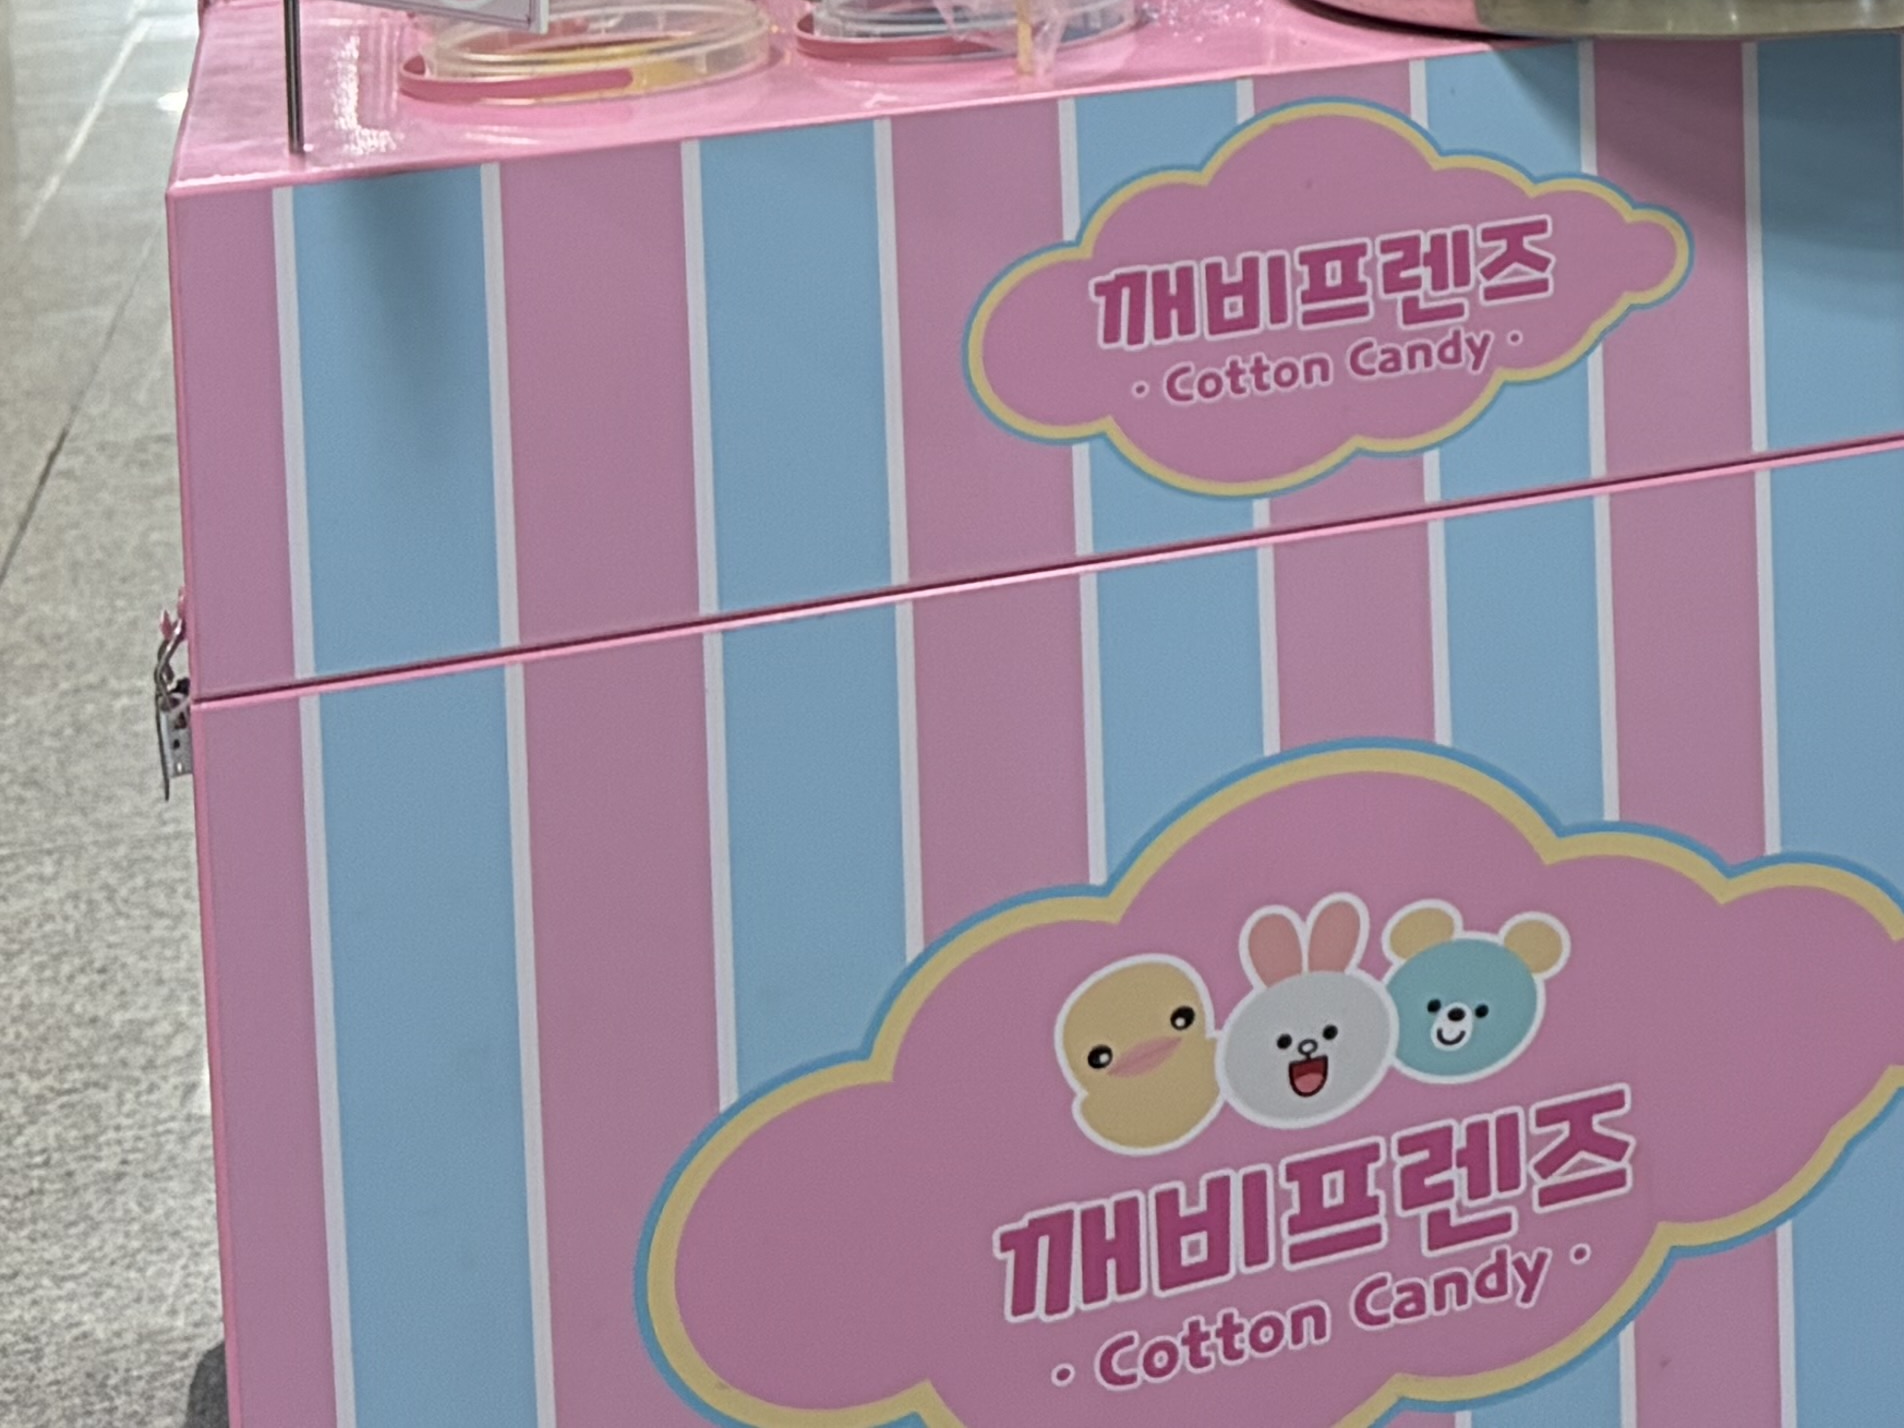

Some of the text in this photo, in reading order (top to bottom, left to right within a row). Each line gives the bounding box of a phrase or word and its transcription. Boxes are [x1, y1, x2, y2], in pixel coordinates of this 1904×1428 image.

[1090, 215, 1554, 348] 깨비프렌즈
[1164, 328, 1493, 404] Cotton Candy
[996, 1084, 1634, 1321] 깨비프렌즈
[1097, 1242, 1552, 1389] Cotton Candy
